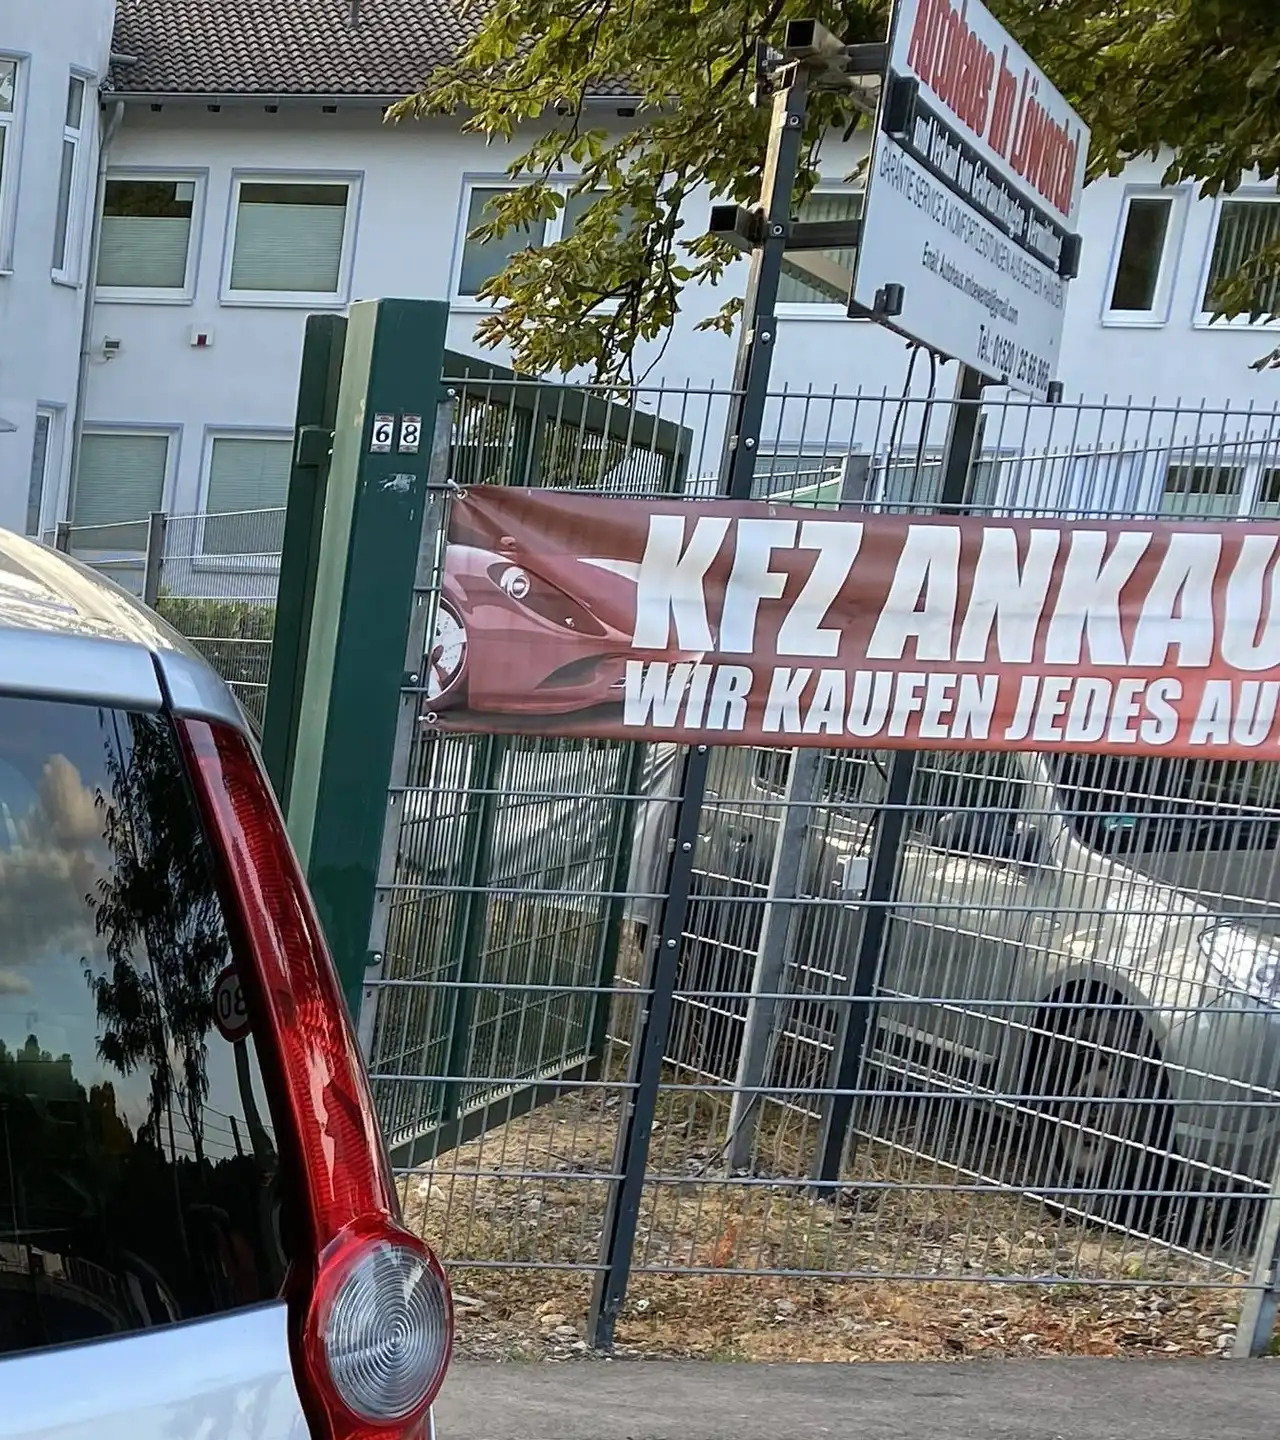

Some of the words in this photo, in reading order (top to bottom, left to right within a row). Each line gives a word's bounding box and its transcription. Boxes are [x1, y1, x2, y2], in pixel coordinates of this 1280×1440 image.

[907, 0, 995, 138] Autohaus
[878, 144, 916, 201] GARANTIE
[912, 173, 944, 223] SERVICE
[631, 514, 864, 657] KFZ
[866, 524, 1280, 671] ANKAU
[623, 660, 753, 731] WIR
[761, 667, 1000, 741] KAUFEN
[1004, 675, 1183, 746] JEDES
